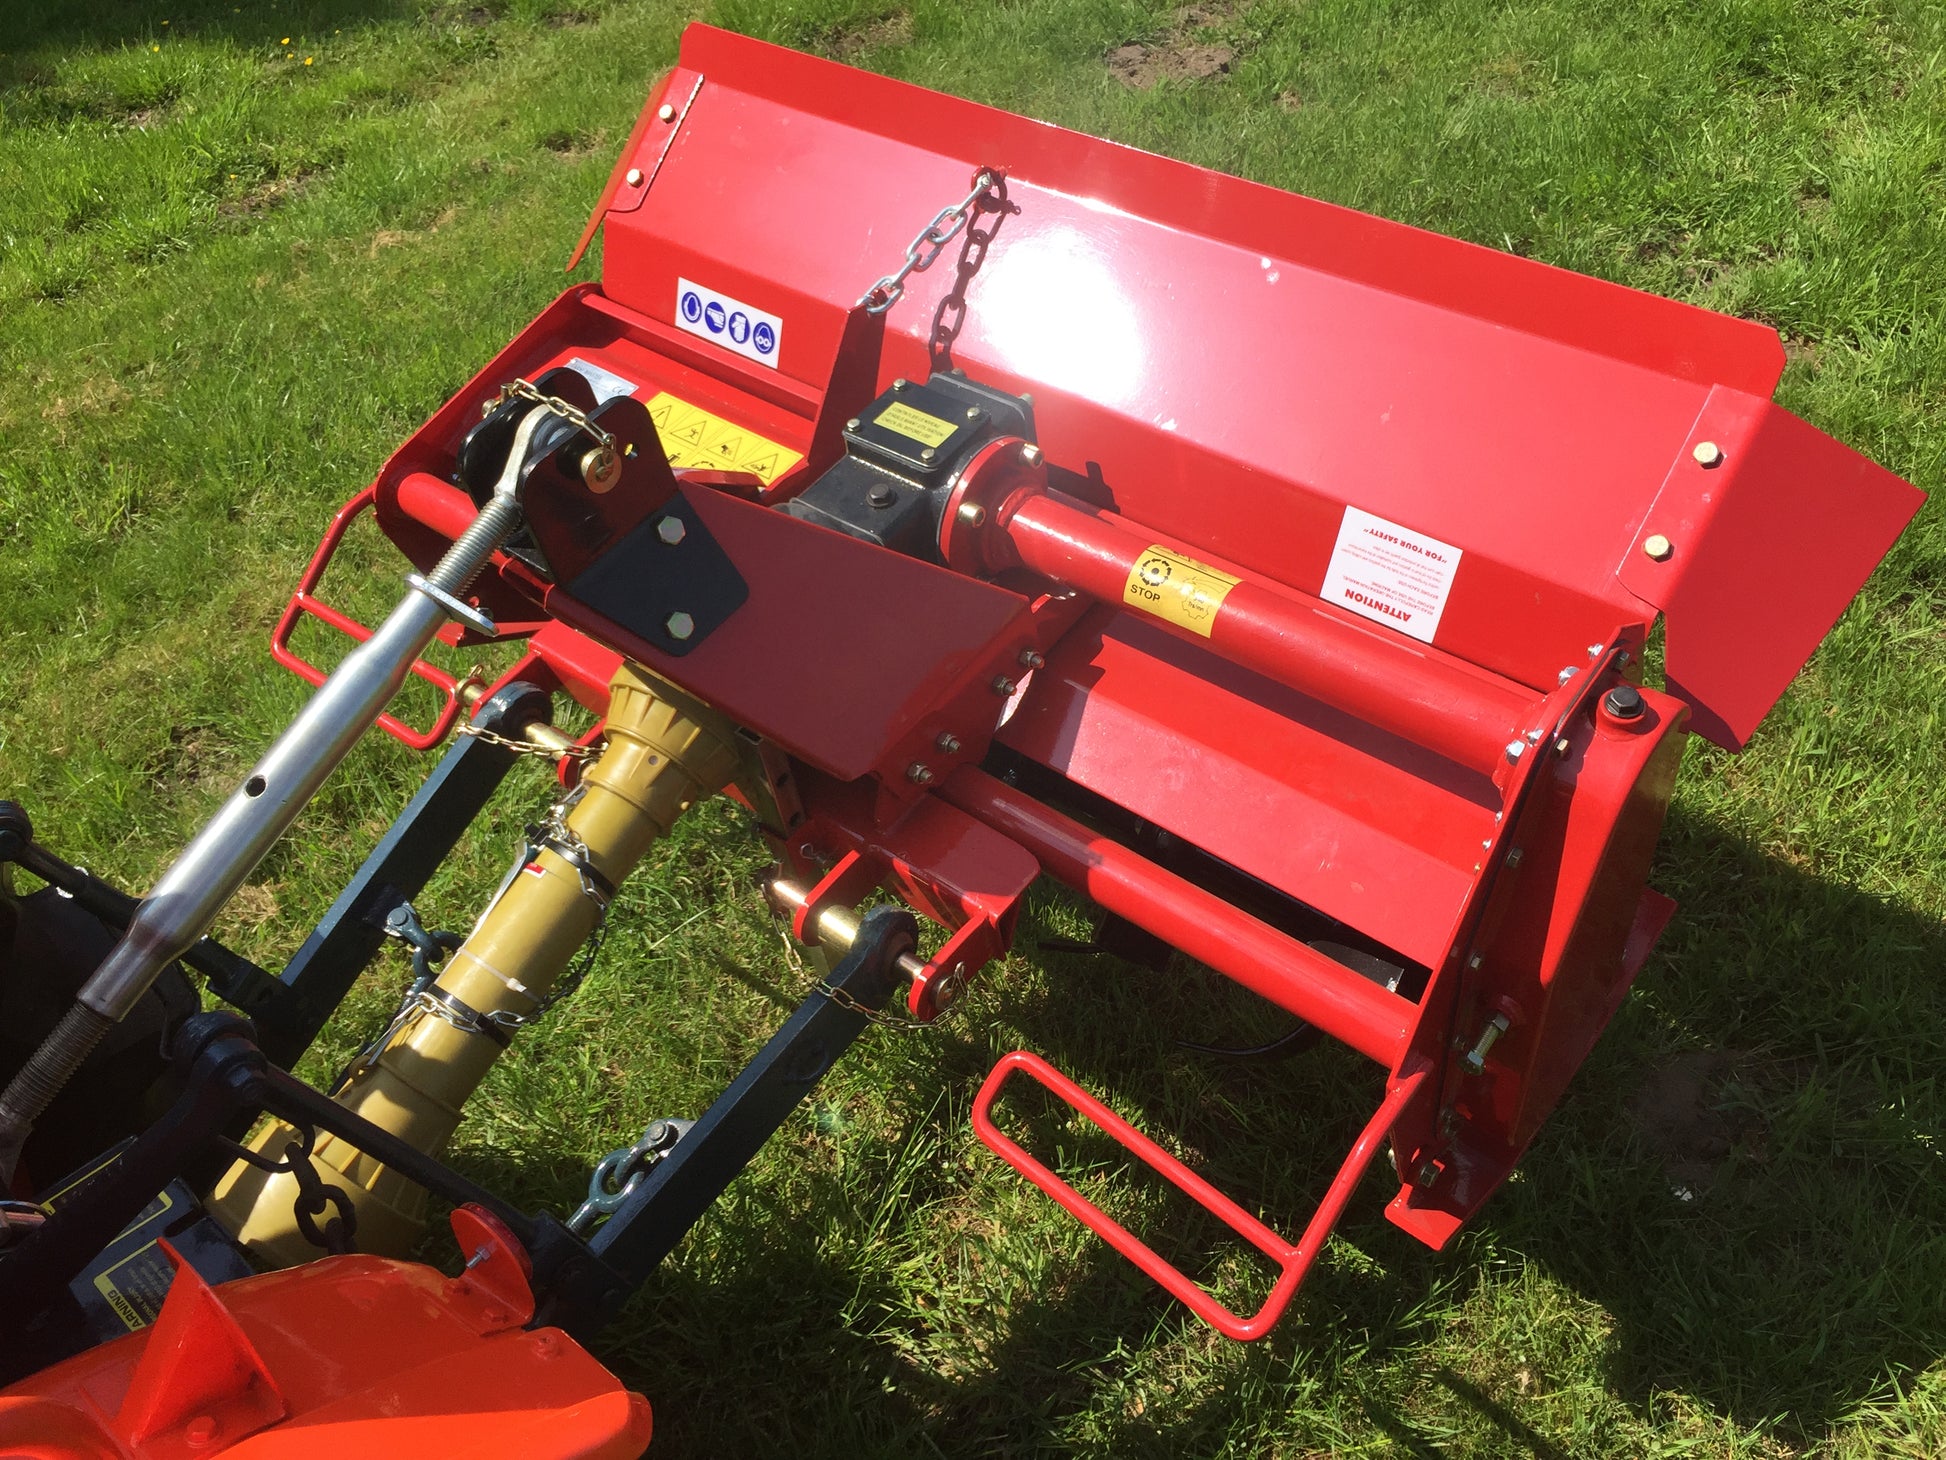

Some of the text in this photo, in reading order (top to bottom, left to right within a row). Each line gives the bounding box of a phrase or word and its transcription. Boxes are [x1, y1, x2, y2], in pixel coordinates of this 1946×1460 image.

[1398, 539, 1424, 554] YOUR
[1130, 583, 1161, 602] STOP
[1344, 588, 1412, 622] ATTENTION
[105, 1286, 143, 1330] ARNING
